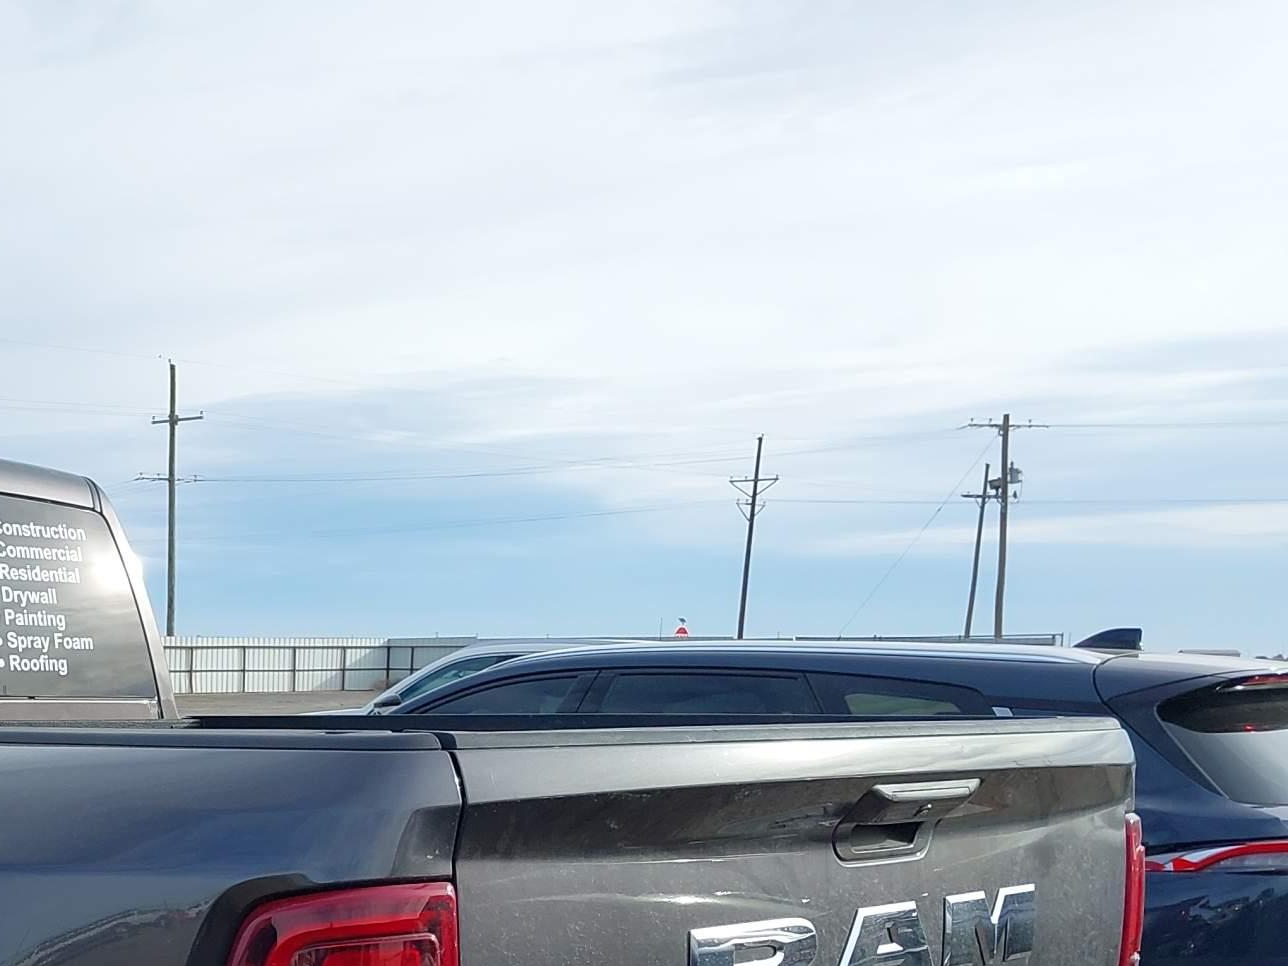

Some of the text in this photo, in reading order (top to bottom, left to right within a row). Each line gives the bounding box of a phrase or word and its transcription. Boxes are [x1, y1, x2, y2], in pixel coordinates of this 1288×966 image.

[1, 585, 58, 607] Drywall
[4, 608, 66, 631] Painting
[6, 631, 94, 653] Spray Foam
[8, 654, 68, 675] Roofing
